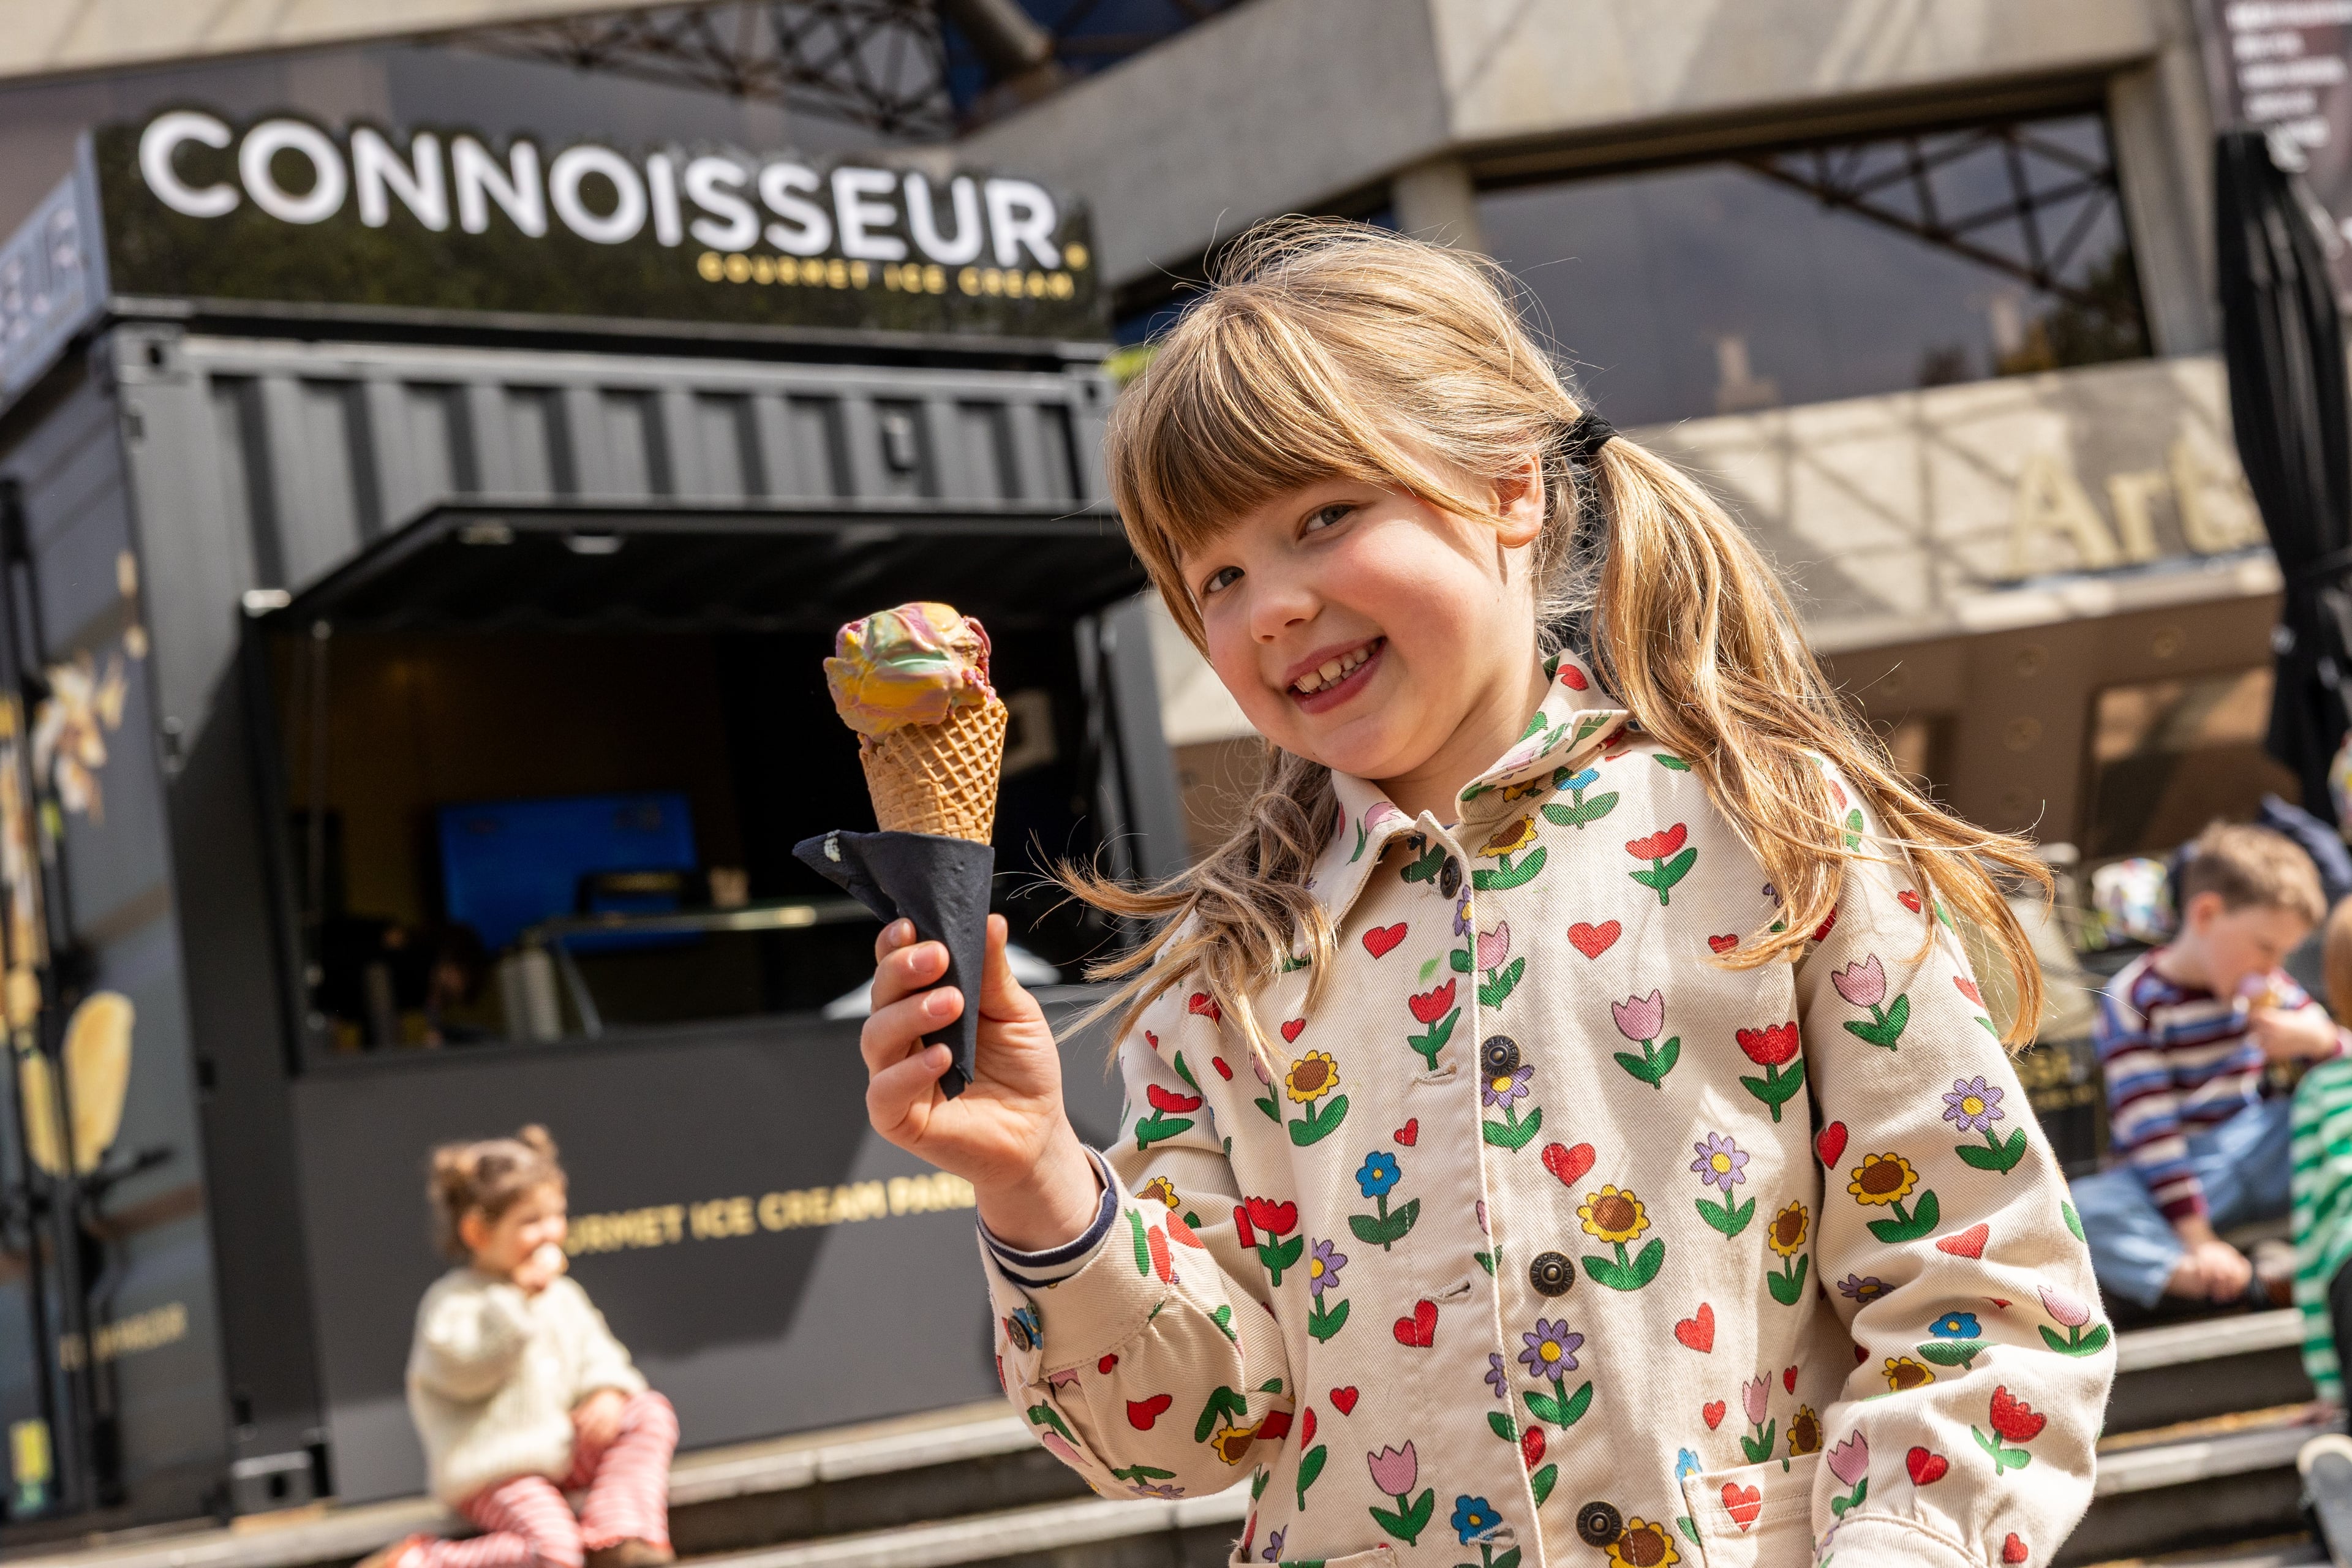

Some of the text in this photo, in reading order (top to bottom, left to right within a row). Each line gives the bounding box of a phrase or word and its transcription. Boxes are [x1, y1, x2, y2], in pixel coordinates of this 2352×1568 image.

[696, 251, 1076, 301] GOURMET ICE CREAM
[1999, 434, 2264, 577] Art
[688, 1196, 756, 1241] ICE
[757, 1186, 888, 1232] CREAM
[886, 1171, 976, 1216] PARL
[1531, 1253, 1563, 1273] BODEN
